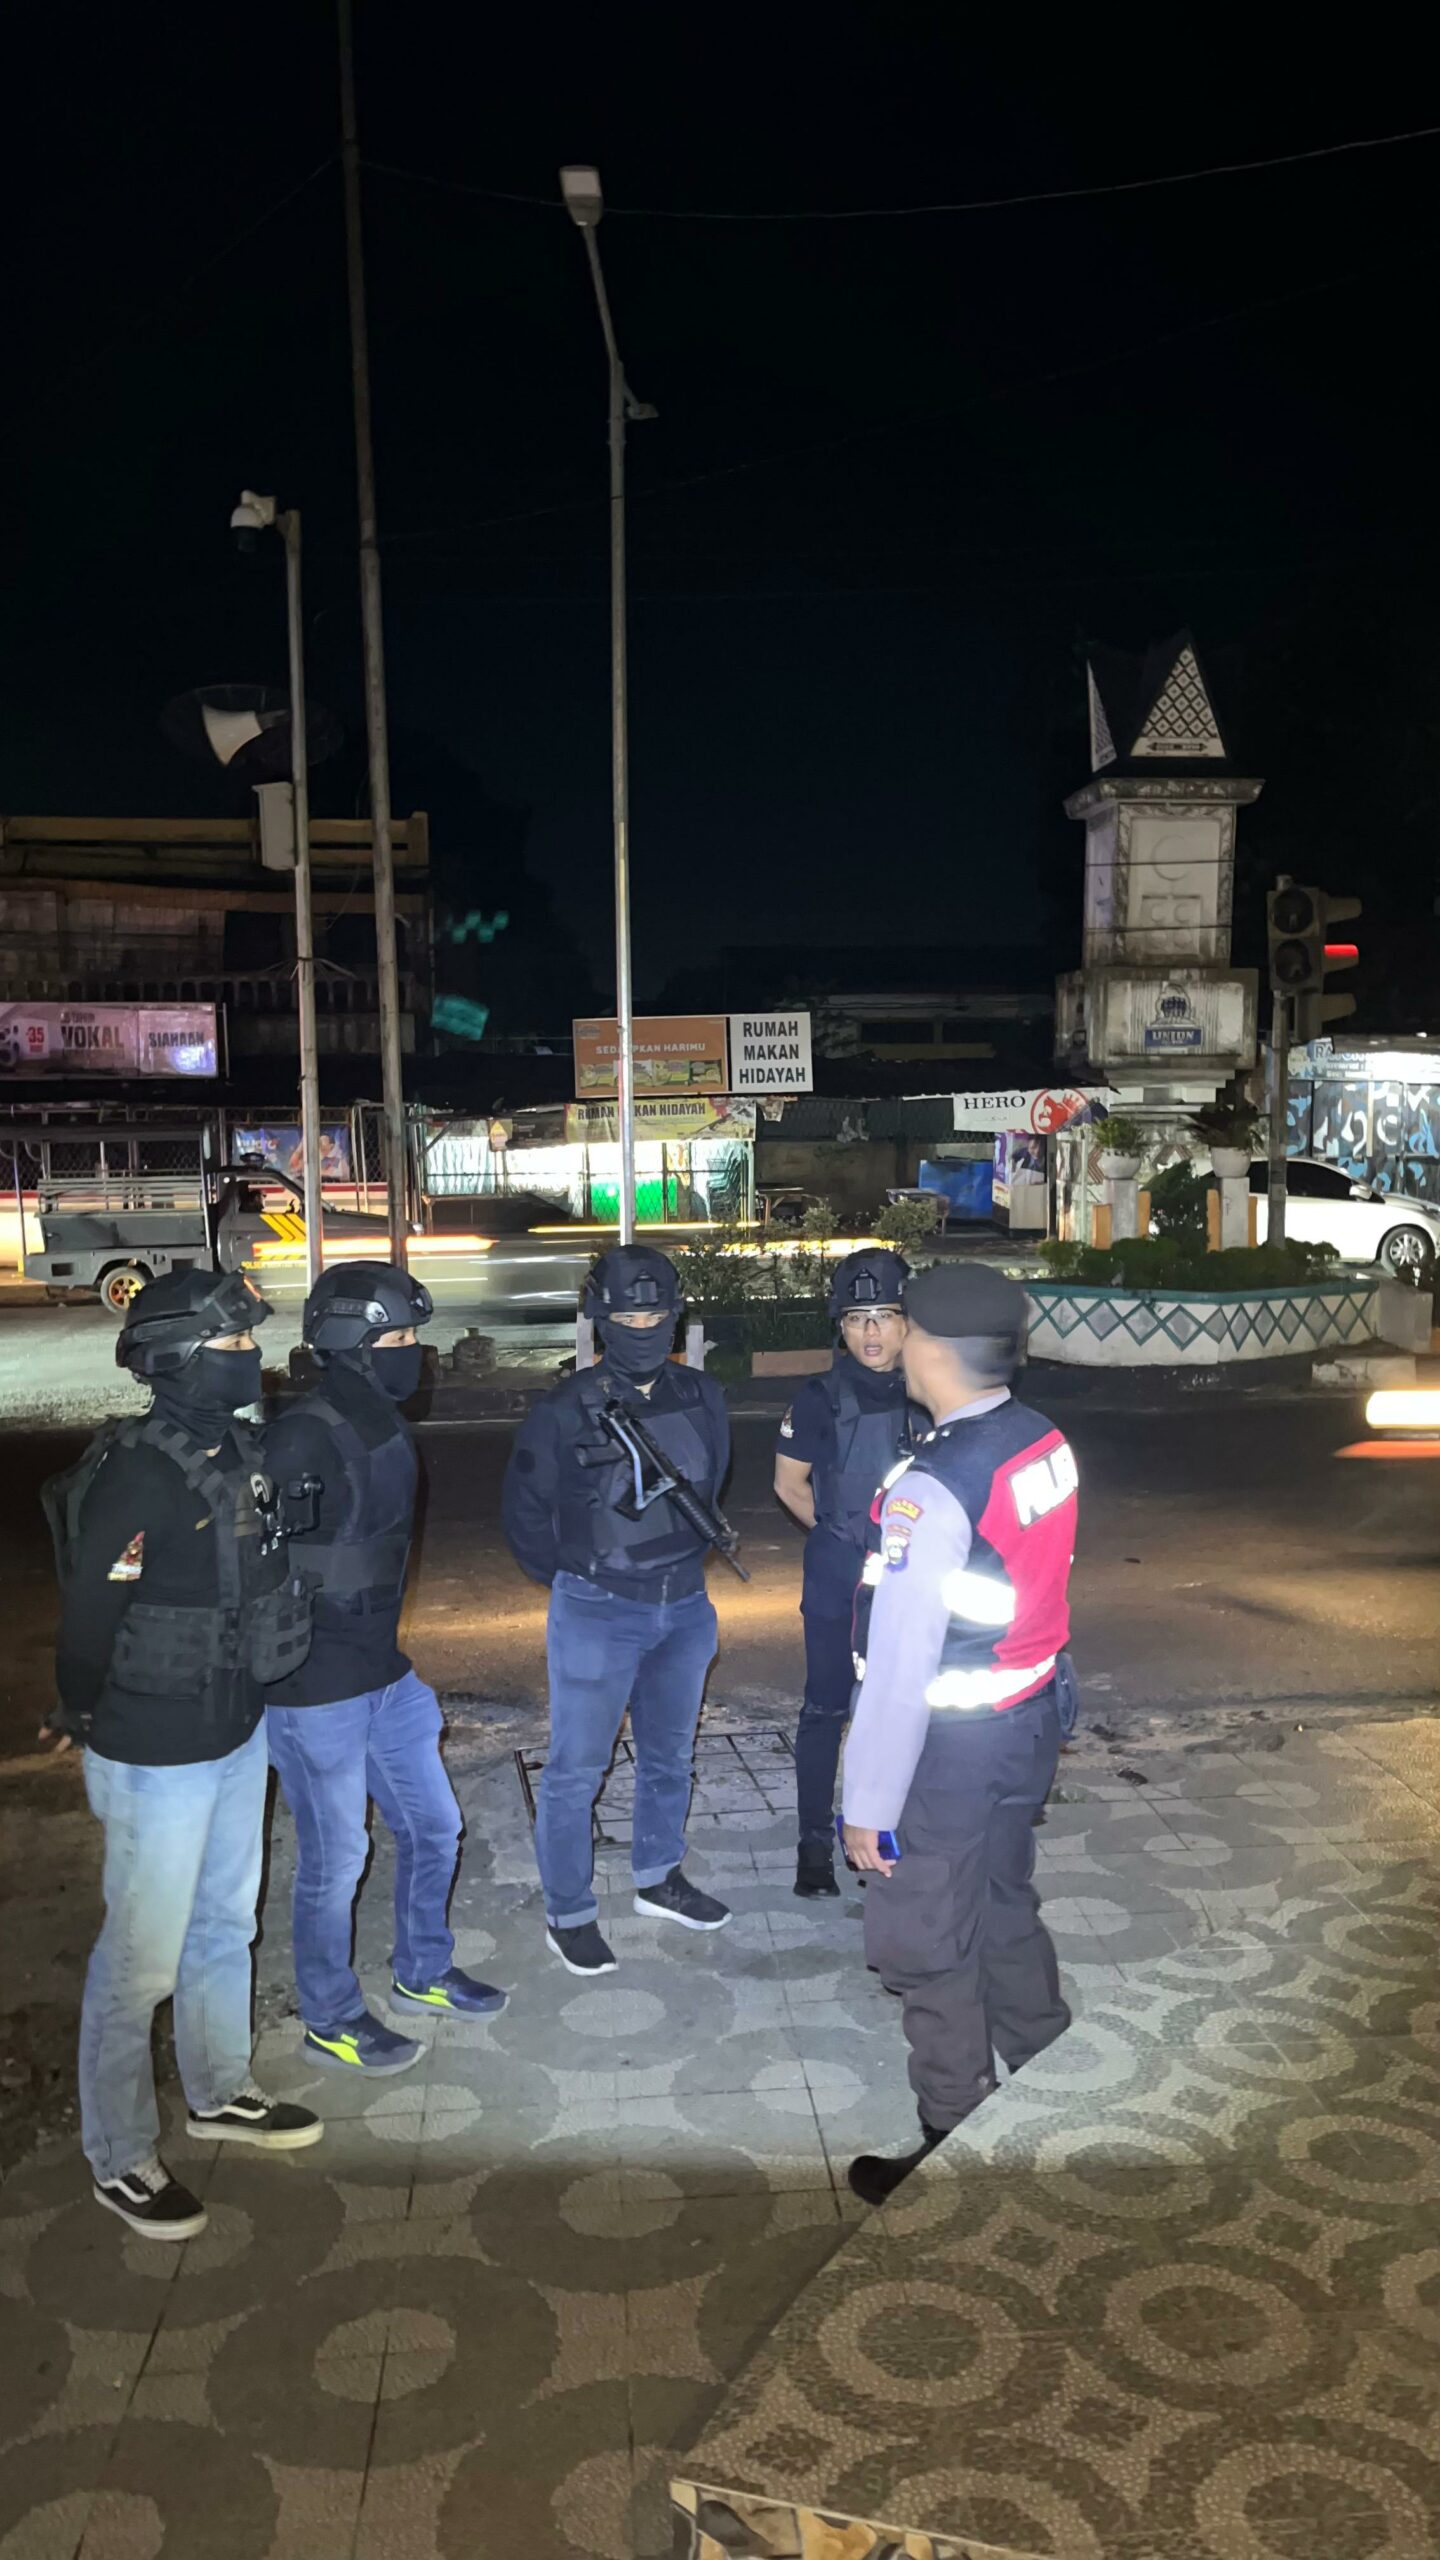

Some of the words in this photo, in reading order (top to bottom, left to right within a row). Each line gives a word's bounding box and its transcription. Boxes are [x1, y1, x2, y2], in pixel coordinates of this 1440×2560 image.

[61, 1026, 125, 1048] VOKAL
[743, 1021, 798, 1037] RUMAH
[595, 1044, 661, 1055] SEDPKAN
[664, 1043, 706, 1052] HARIMU
[744, 1044, 799, 1060] MAKAN
[740, 1067, 805, 1084] HIDAYAH
[660, 1103, 706, 1116] HIDAYAH
[965, 1096, 1026, 1110] HERO
